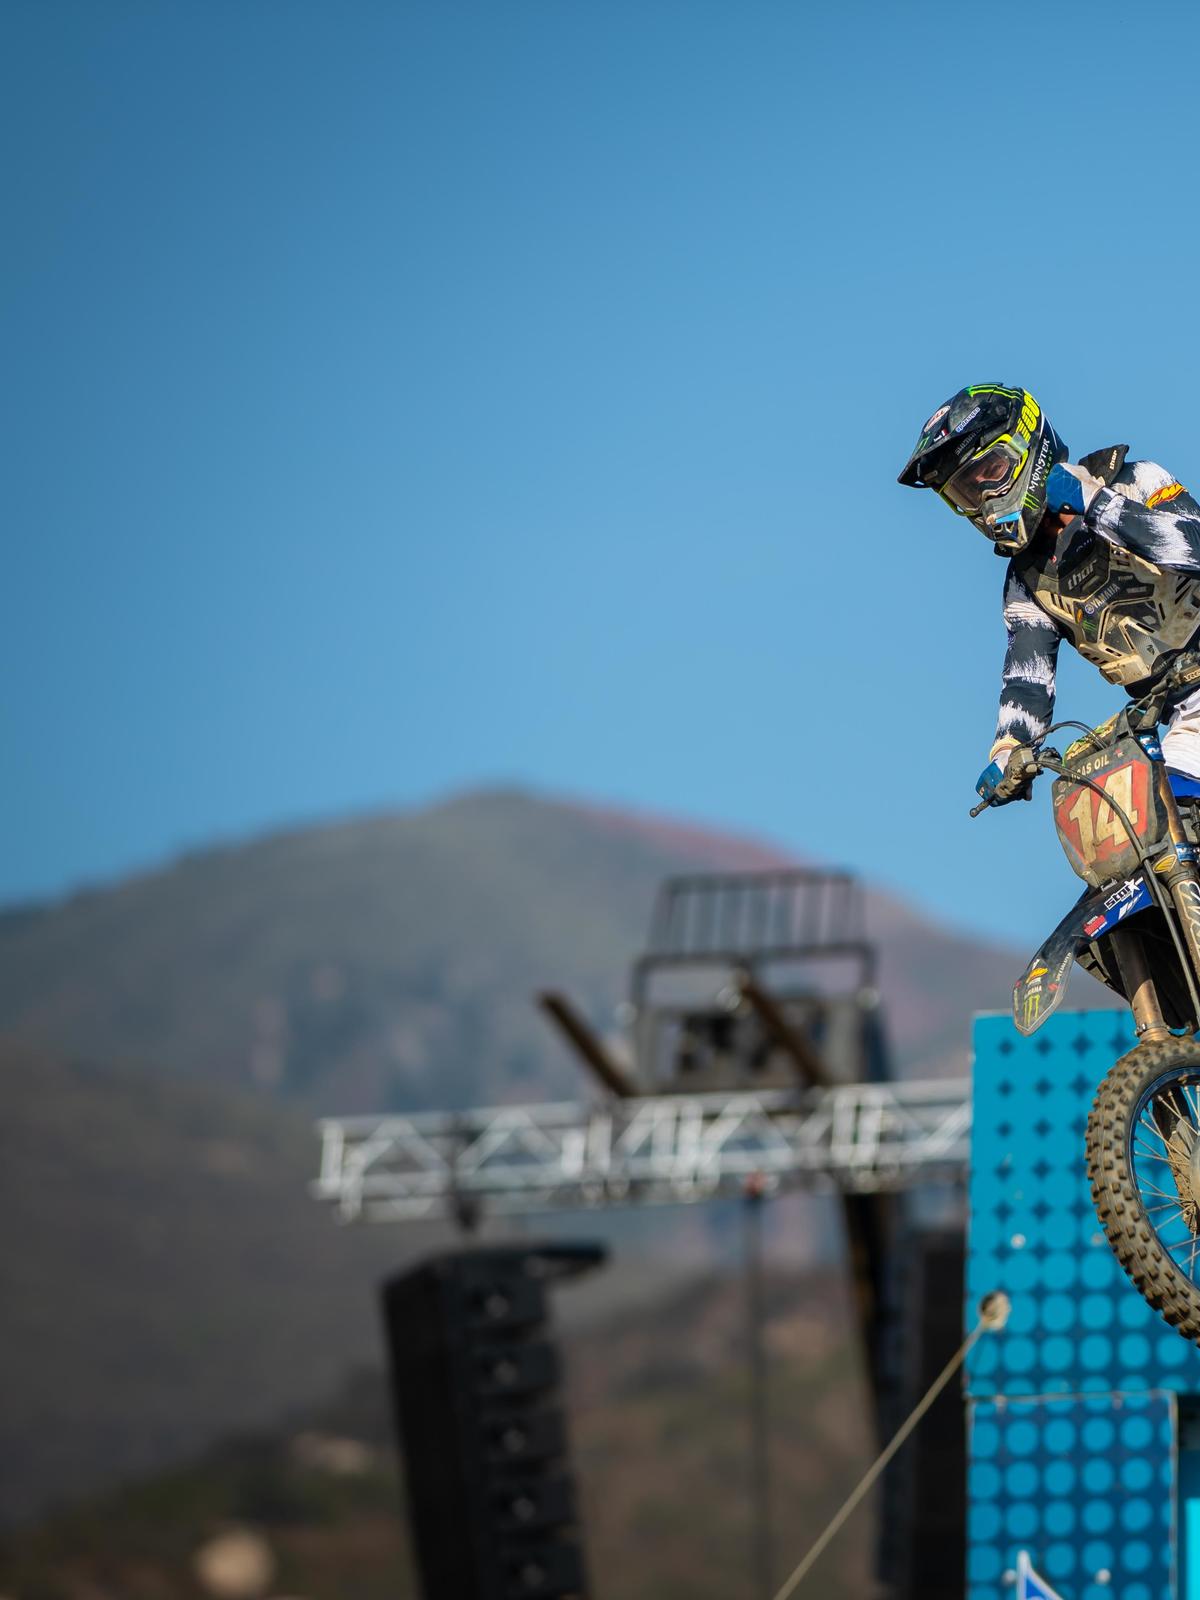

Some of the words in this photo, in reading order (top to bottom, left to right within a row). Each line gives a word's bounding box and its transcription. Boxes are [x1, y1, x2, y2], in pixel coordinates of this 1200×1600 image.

[1067, 559, 1097, 591] thor
[1091, 583, 1121, 609] YAMAHA
[1091, 757, 1109, 772] OIL
[1069, 765, 1138, 866] 14
